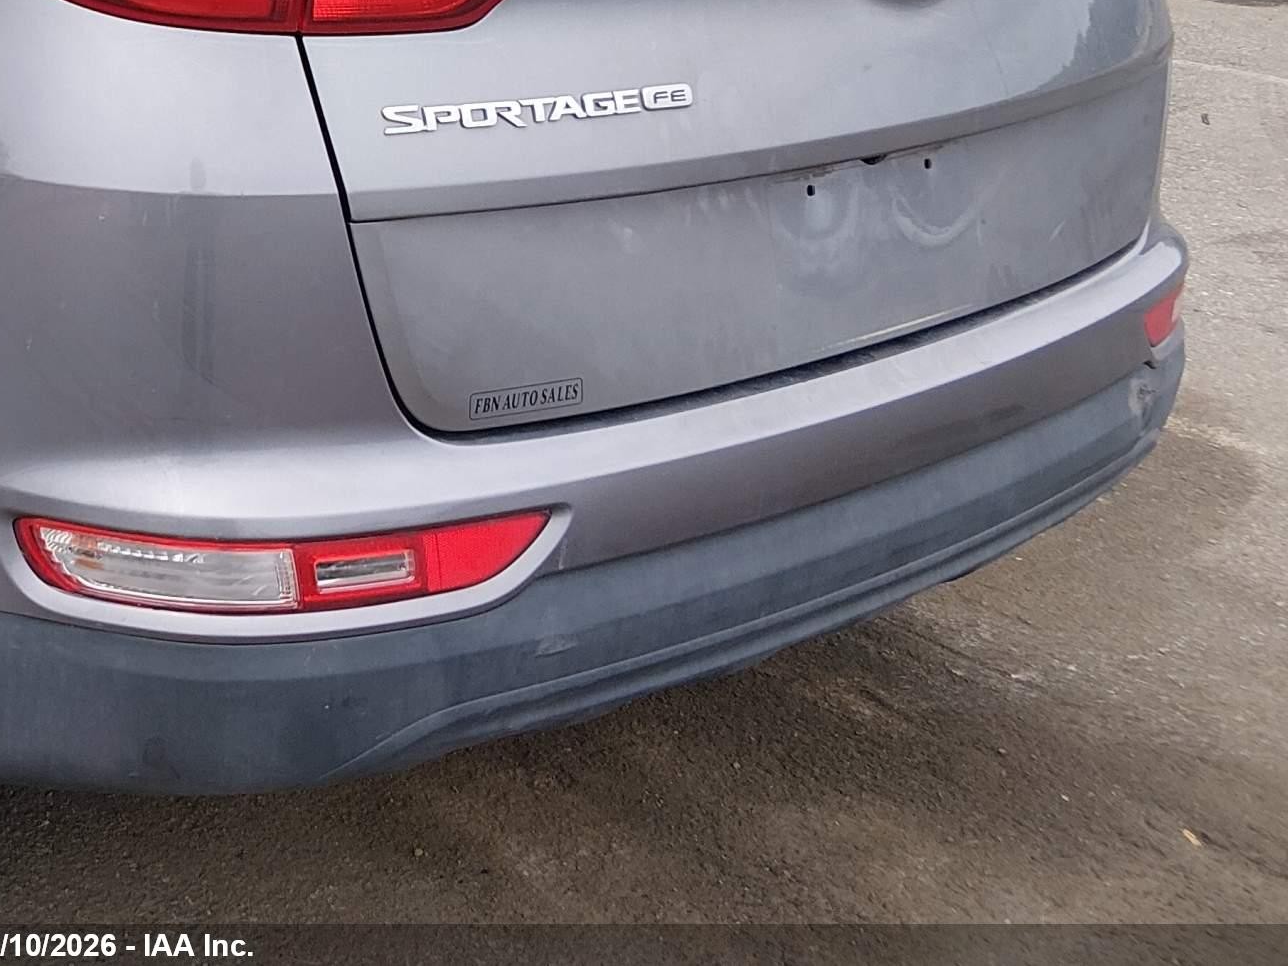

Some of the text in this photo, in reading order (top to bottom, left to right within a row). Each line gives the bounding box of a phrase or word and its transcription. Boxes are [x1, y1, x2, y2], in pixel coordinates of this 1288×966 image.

[381, 89, 643, 135] SPORTAGE
[475, 383, 579, 414] FBN AUTO SALES
